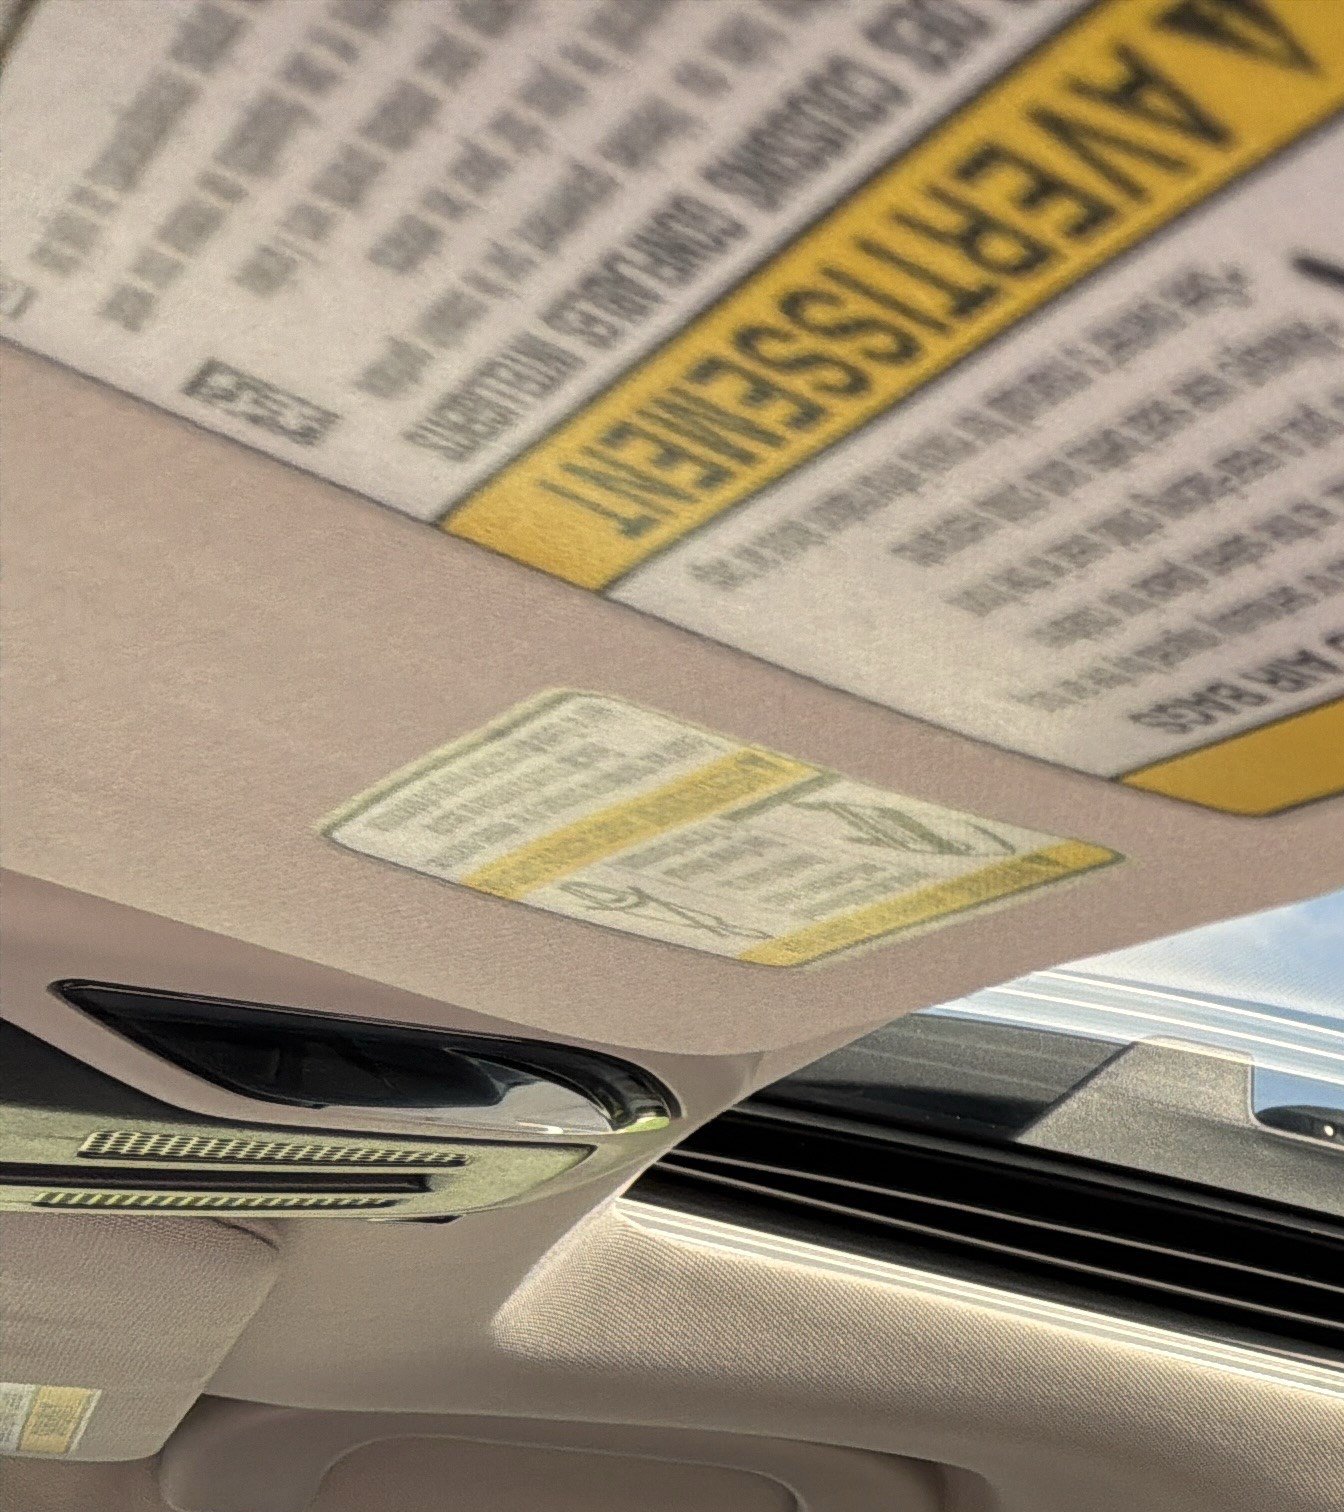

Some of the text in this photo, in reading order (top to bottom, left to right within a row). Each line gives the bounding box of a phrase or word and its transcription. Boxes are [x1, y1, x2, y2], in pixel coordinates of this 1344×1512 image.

[694, 52, 927, 216] COUSSINS
[515, 35, 1275, 541] AVERTISSEMENT
[534, 192, 762, 352] GONFLABLES
[397, 329, 596, 466] INTELLIGENTS
[1123, 677, 1278, 739] BAGS
